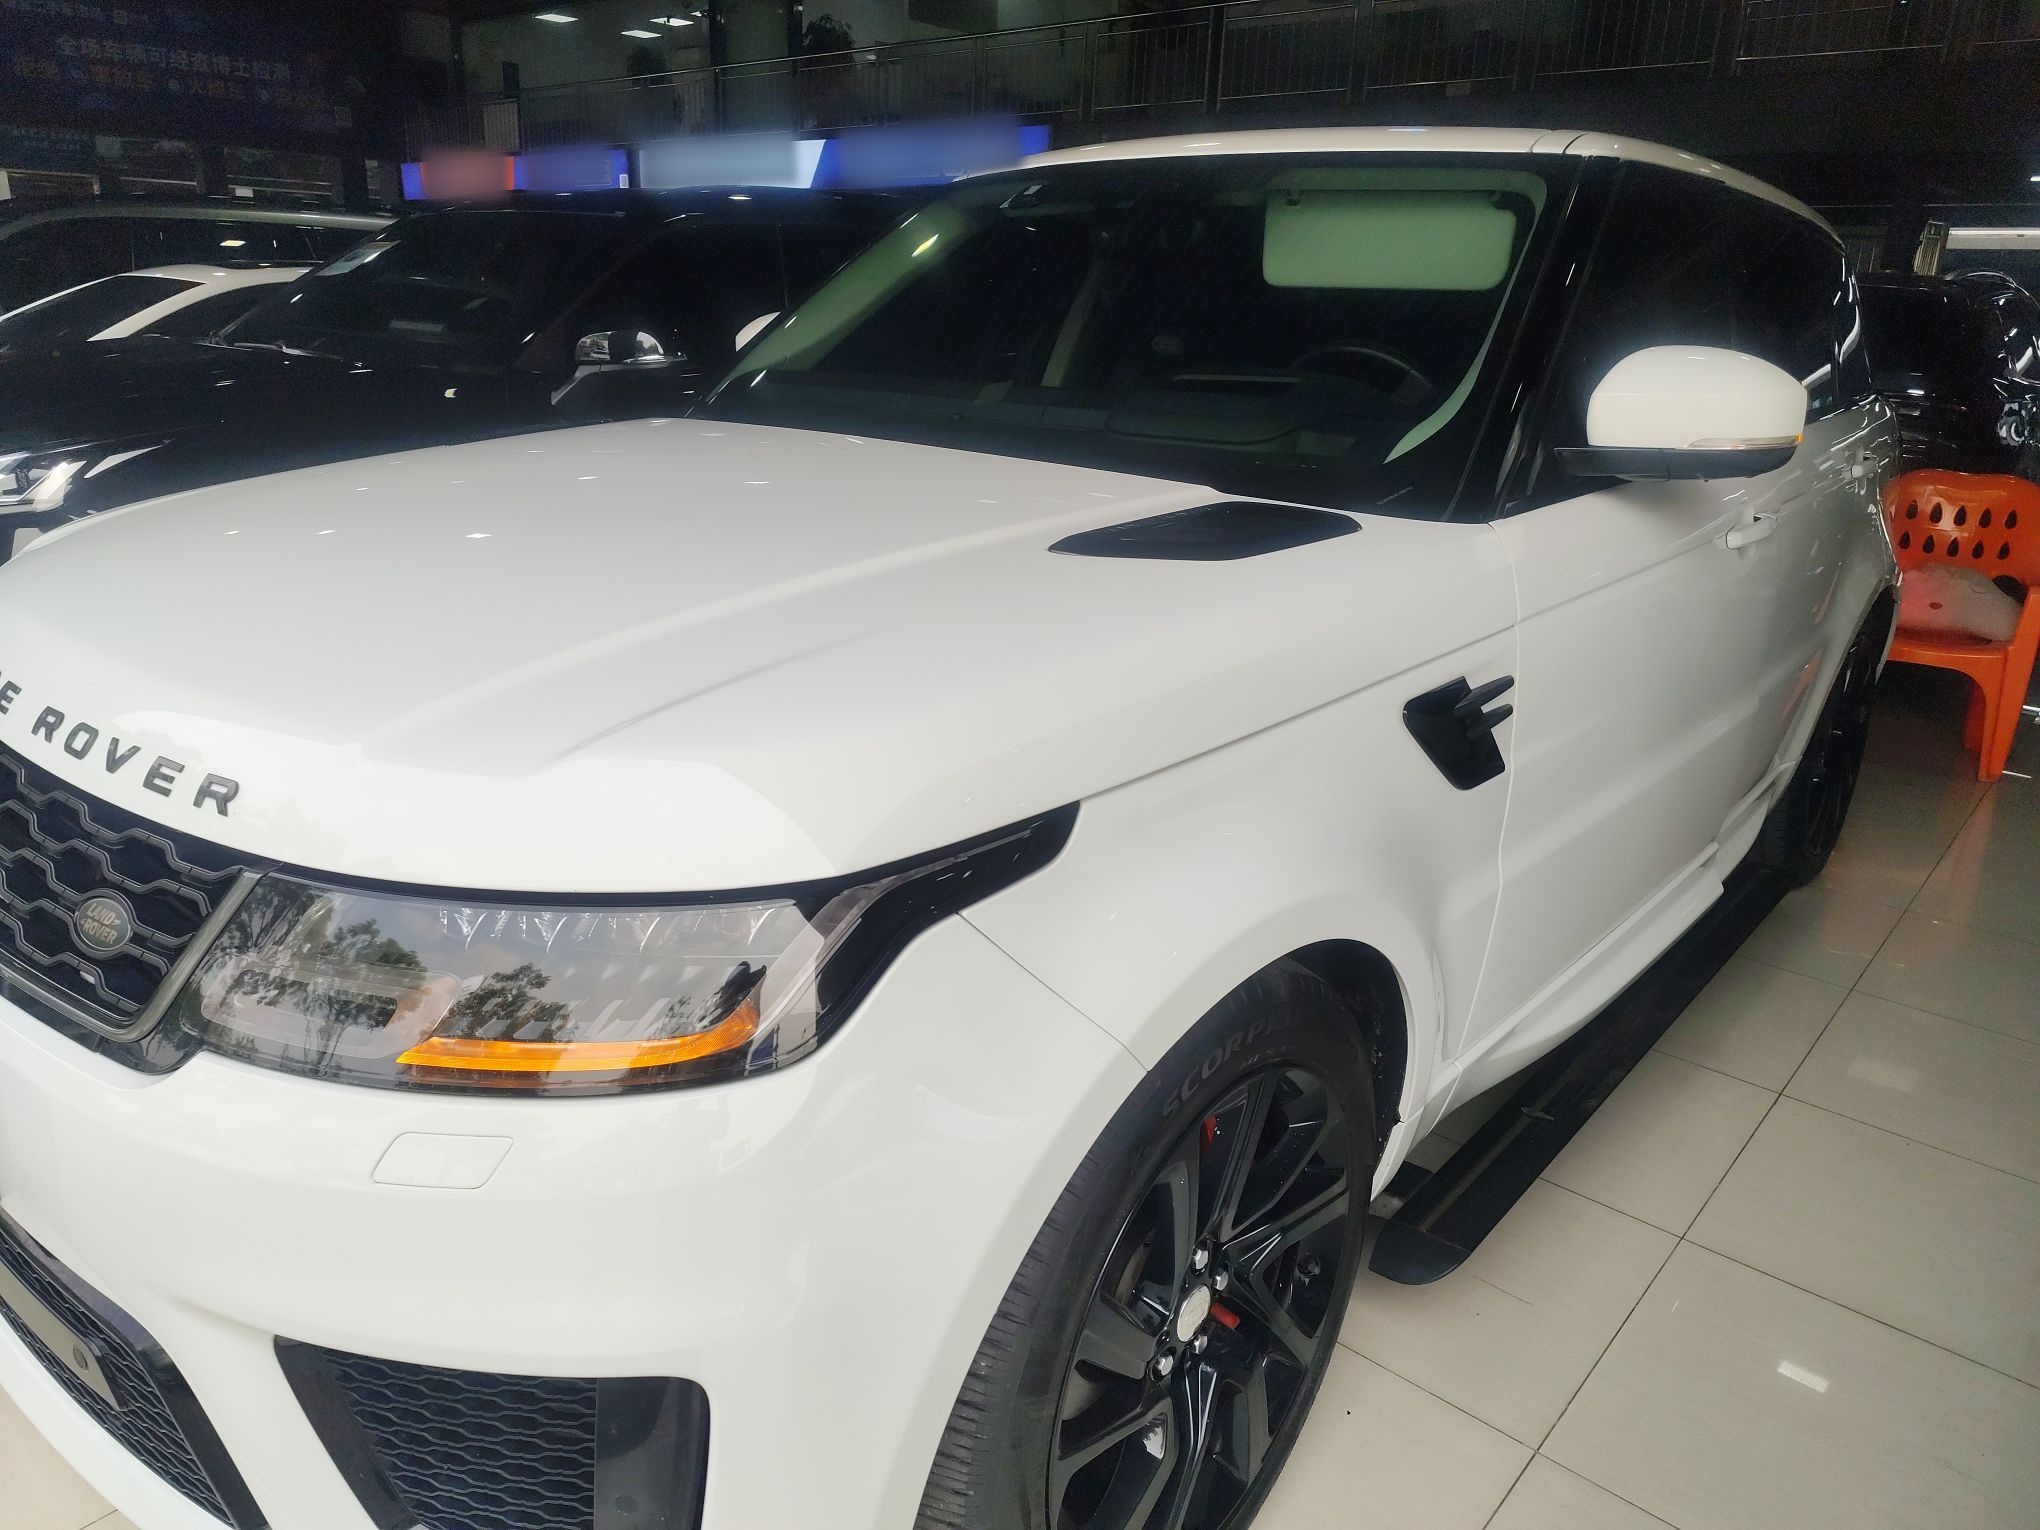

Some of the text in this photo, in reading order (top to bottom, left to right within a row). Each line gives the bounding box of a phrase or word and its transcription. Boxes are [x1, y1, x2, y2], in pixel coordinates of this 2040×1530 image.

[31, 705, 240, 817] ROVER
[86, 902, 116, 925] LAND
[83, 917, 118, 945] ROVER
